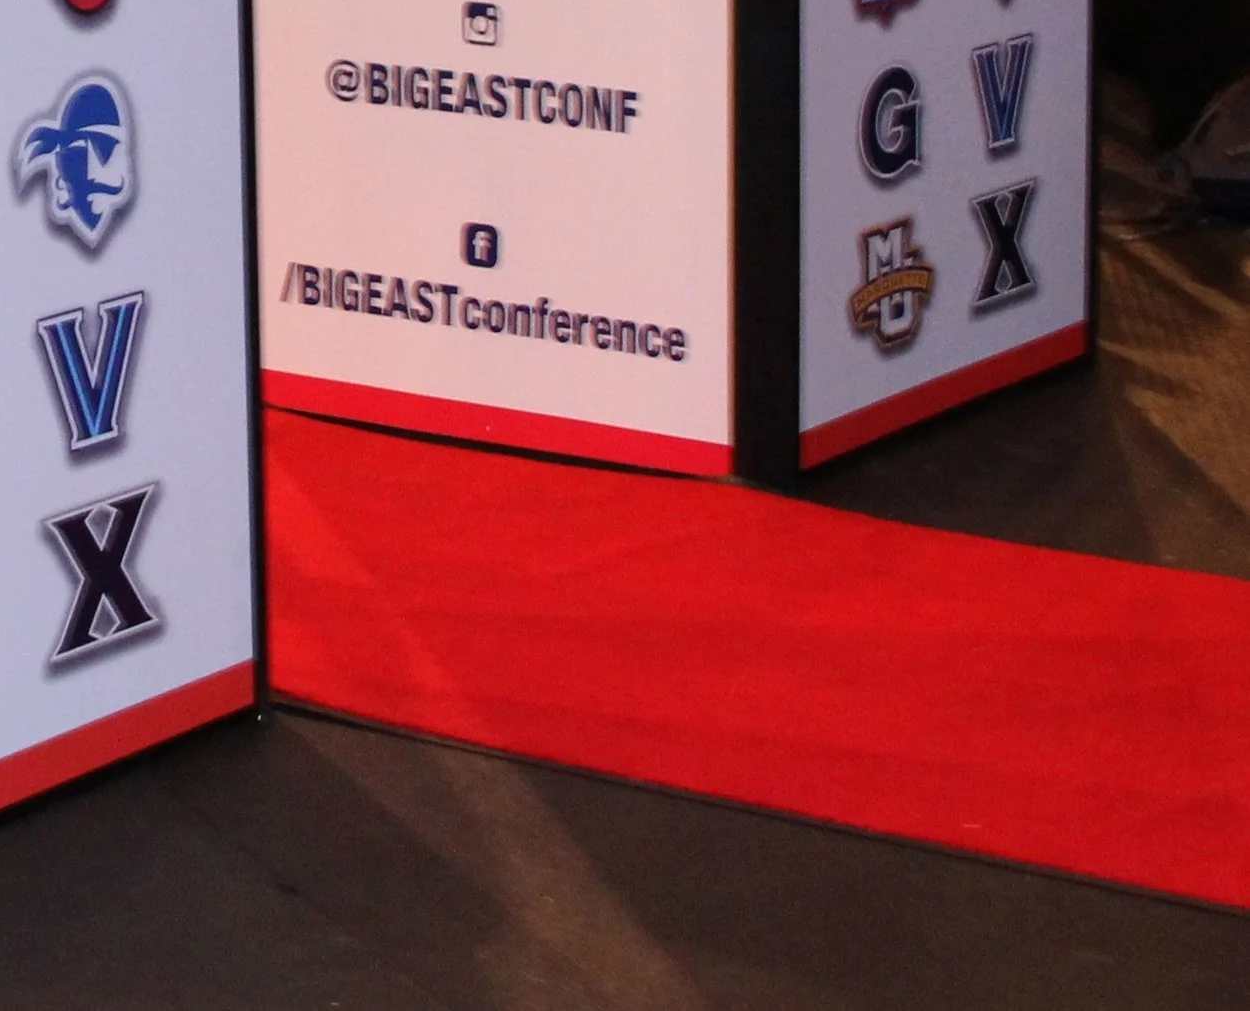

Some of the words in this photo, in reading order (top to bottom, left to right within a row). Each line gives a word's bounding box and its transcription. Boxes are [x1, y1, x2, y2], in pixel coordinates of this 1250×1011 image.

[325, 59, 637, 133] @BIGEASTCONF
[859, 65, 920, 178] G
[970, 178, 1036, 307] X
[36, 291, 144, 450] V
[279, 262, 686, 362] /BIGEASTconference
[44, 482, 159, 661] X
